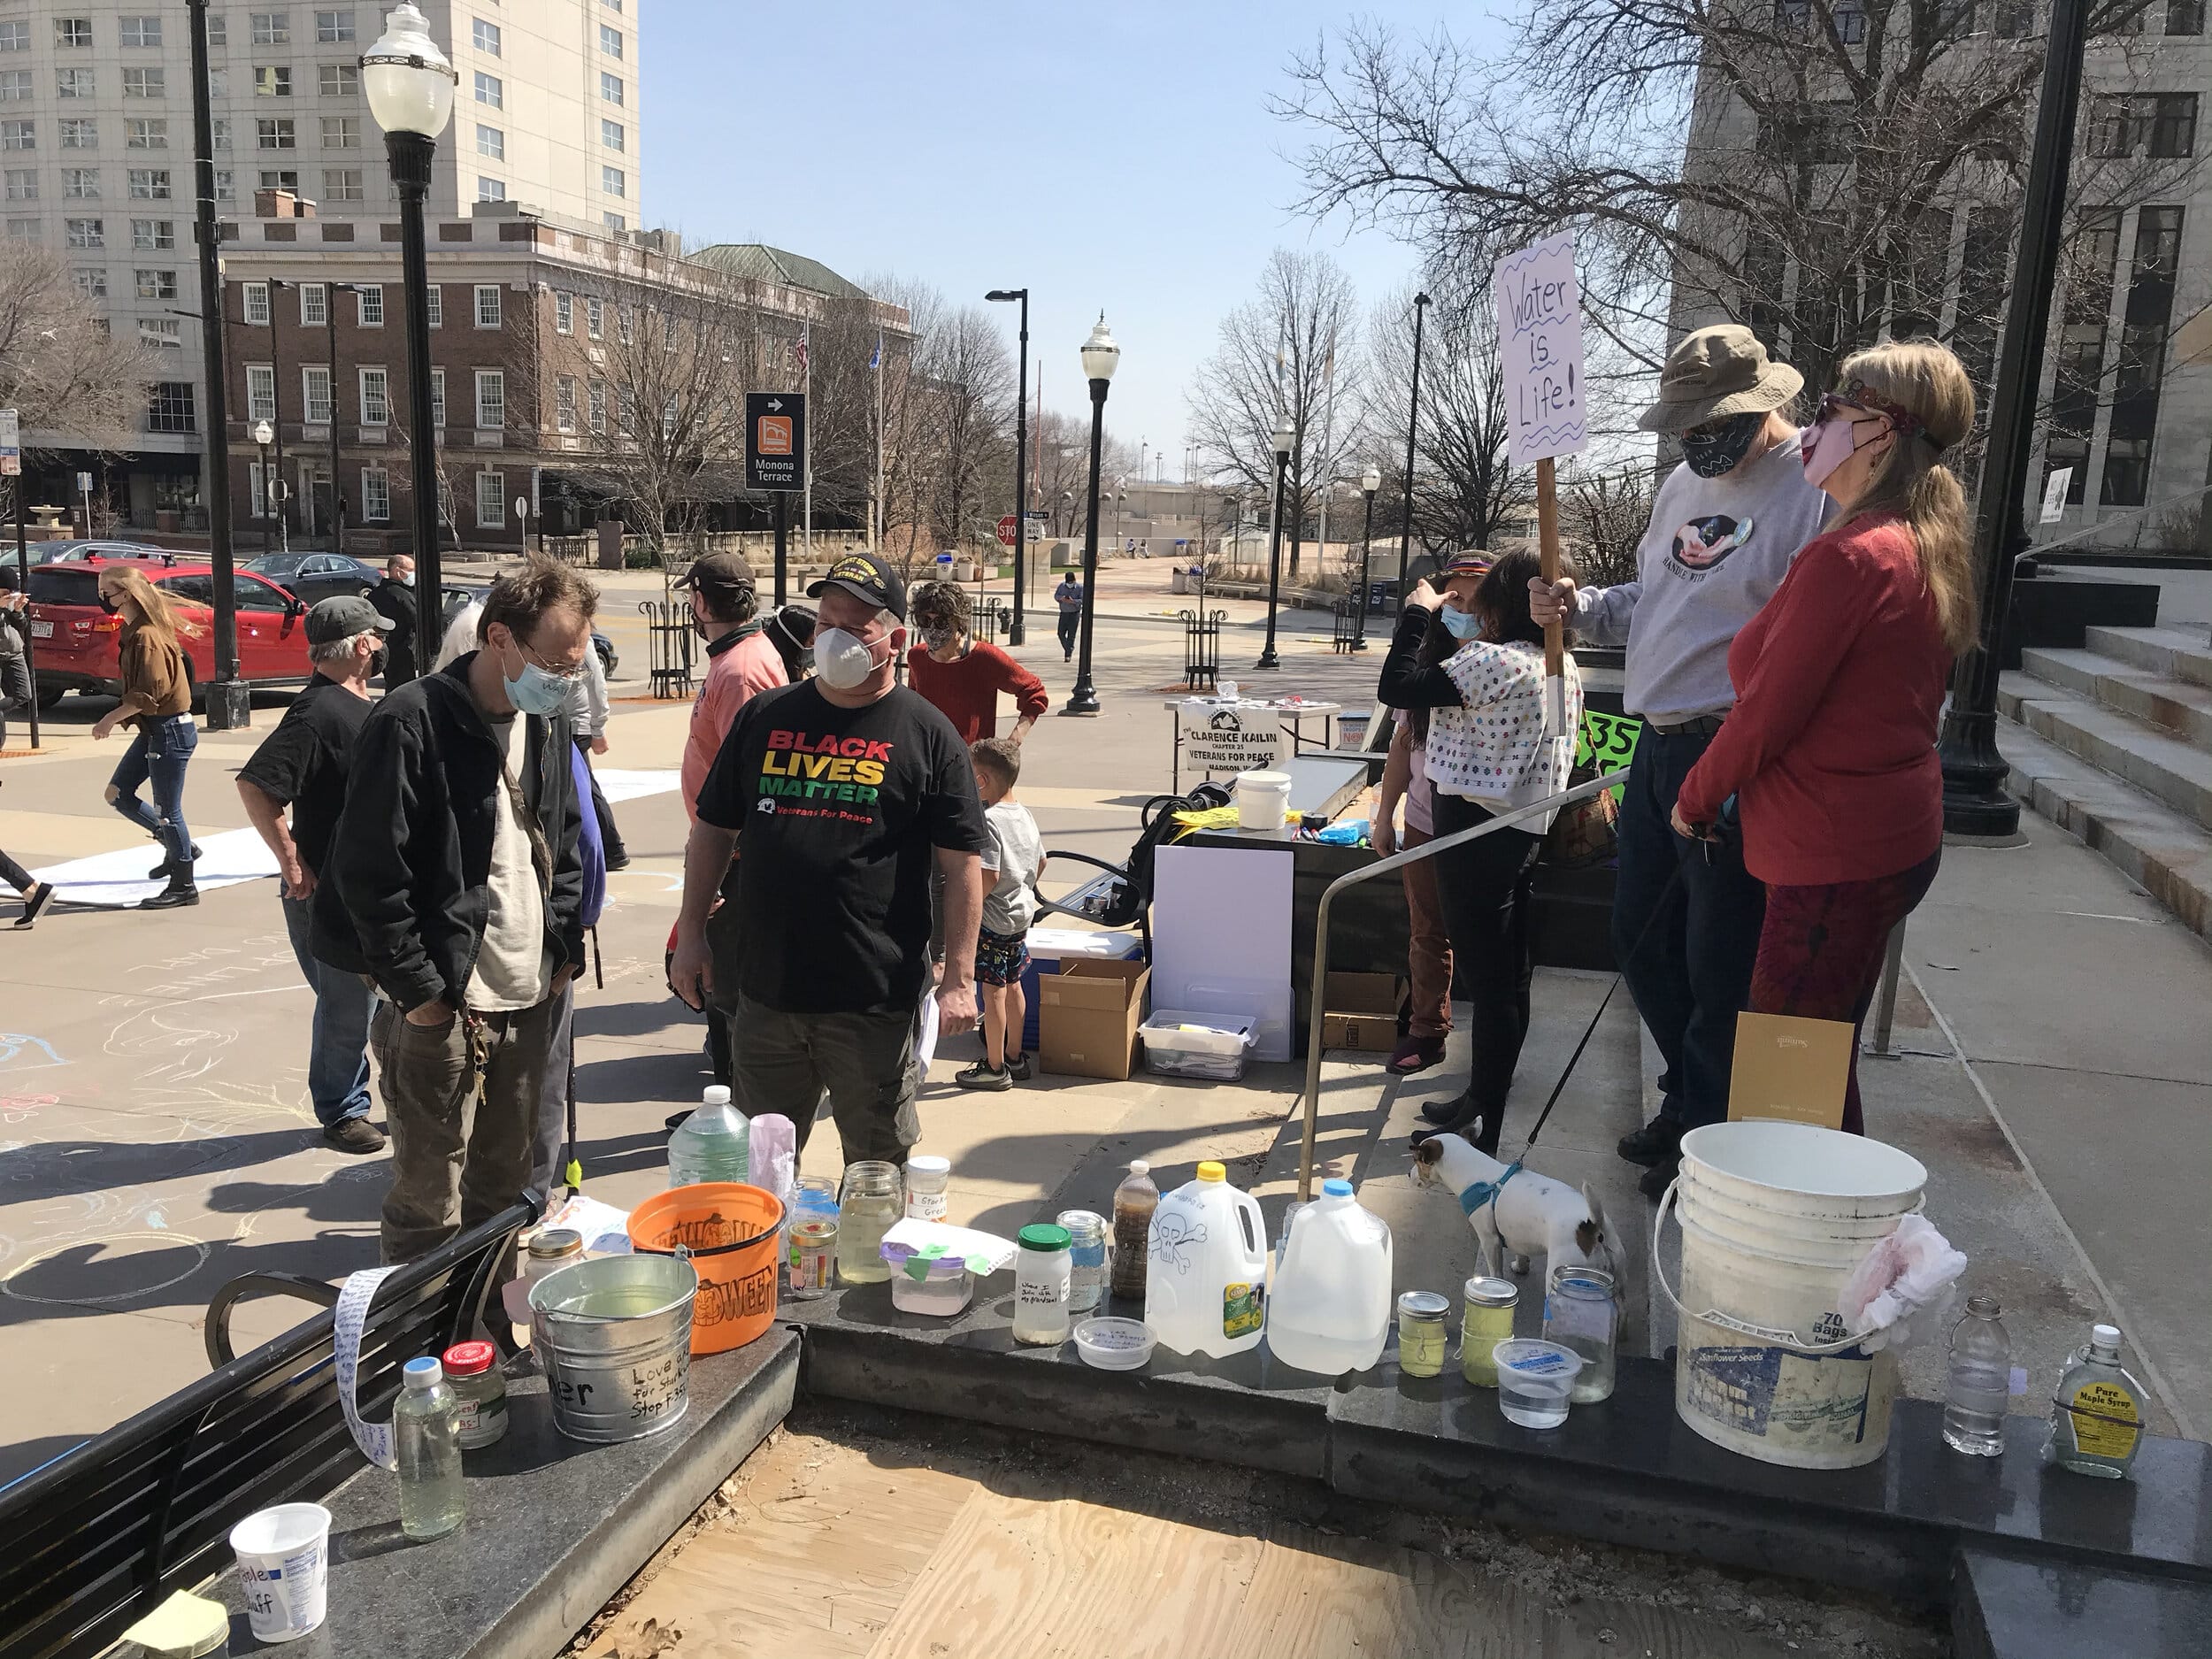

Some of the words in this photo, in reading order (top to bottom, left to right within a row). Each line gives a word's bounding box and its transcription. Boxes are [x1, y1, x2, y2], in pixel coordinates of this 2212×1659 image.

[1507, 273, 1566, 328] Water
[1531, 333, 1548, 363] is
[1519, 363, 1575, 426] Life!
[756, 459, 794, 470] Monona
[757, 471, 792, 481] Terrace
[999, 526, 1017, 537] STO
[856, 557, 879, 576] STORM
[1191, 731, 1239, 743] CLARENCE
[1241, 733, 1277, 743] KAILIN
[767, 729, 895, 763] BLACK
[1189, 750, 1226, 761] VETERANS
[1228, 753, 1245, 762] FOR
[1247, 752, 1275, 762] PEACE
[762, 751, 886, 786] LIVES
[758, 777, 879, 806] MATTER
[776, 806, 818, 818] Veterans
[820, 809, 837, 818] For
[839, 810, 873, 824] Peace
[1824, 1311, 1843, 1326] 70
[1813, 1322, 1847, 1338] Bags
[1700, 1352, 1738, 1362] Sunflower
[1739, 1352, 1763, 1362] Seeds
[633, 1360, 672, 1386] Love
[2079, 1392, 2105, 1405] Maple
[2107, 1398, 2131, 1409] Syrup
[2095, 1386, 2119, 1398] Pure
[630, 1402, 663, 1419] Stop
